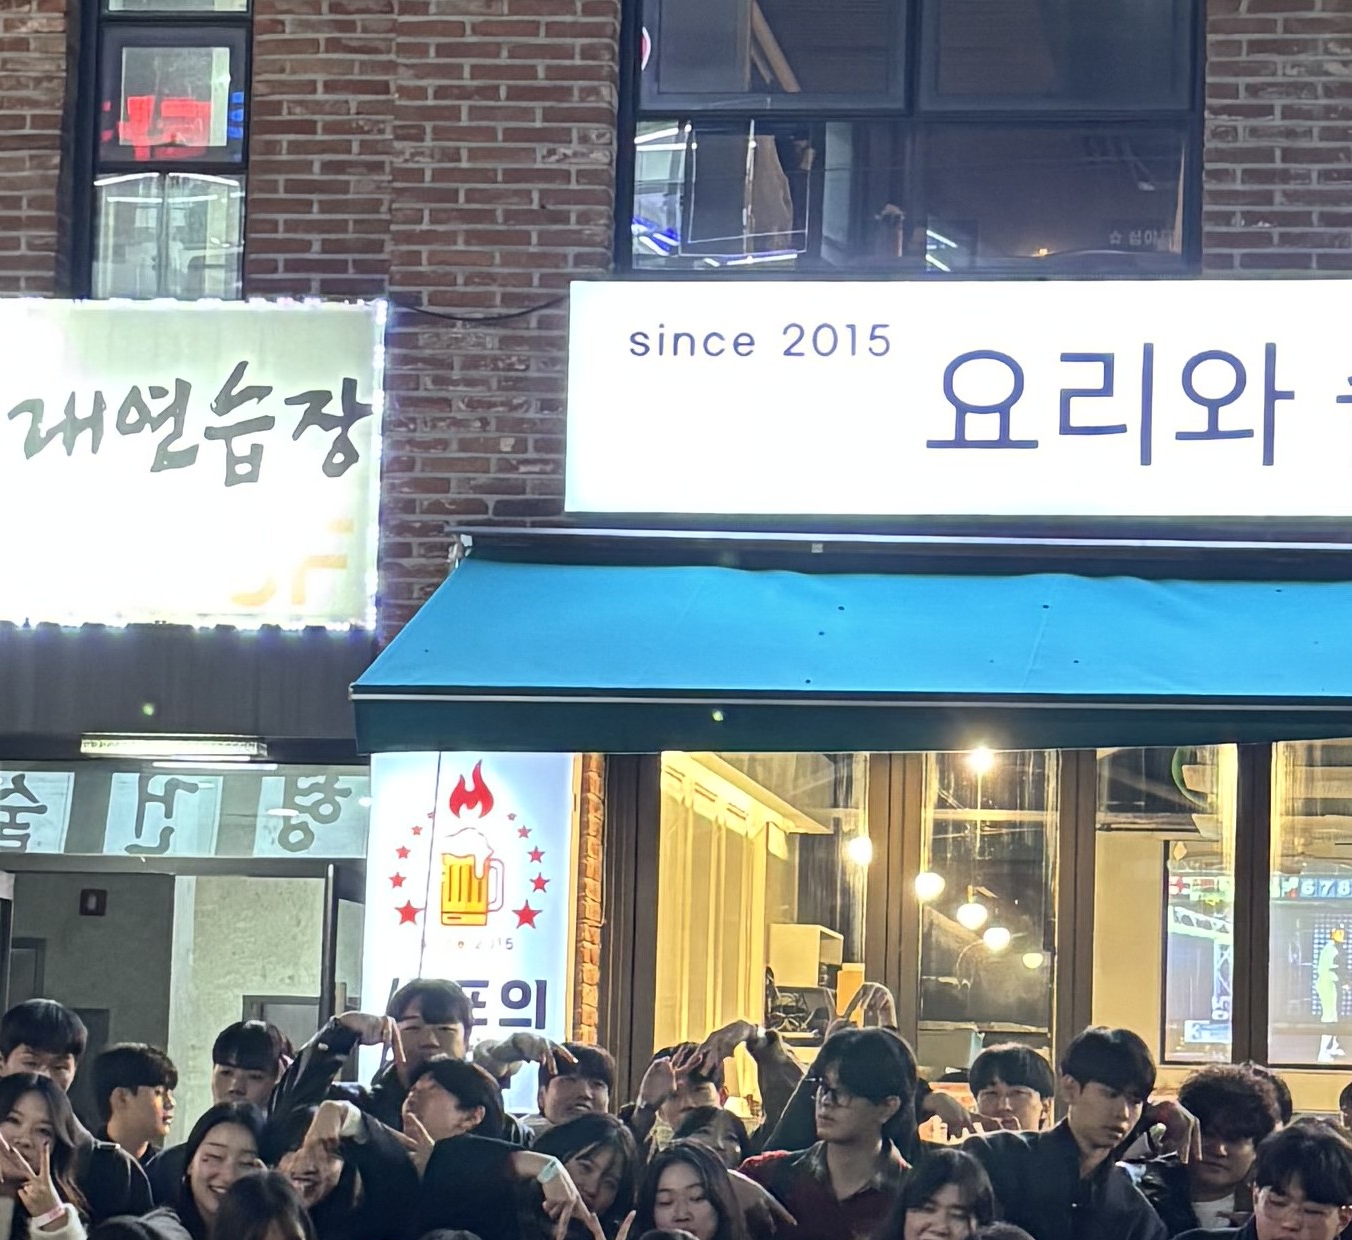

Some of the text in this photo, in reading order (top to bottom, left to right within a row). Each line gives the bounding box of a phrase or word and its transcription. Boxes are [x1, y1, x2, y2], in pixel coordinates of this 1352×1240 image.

[629, 323, 891, 357] since 2015
[926, 342, 1295, 466] 요리와
